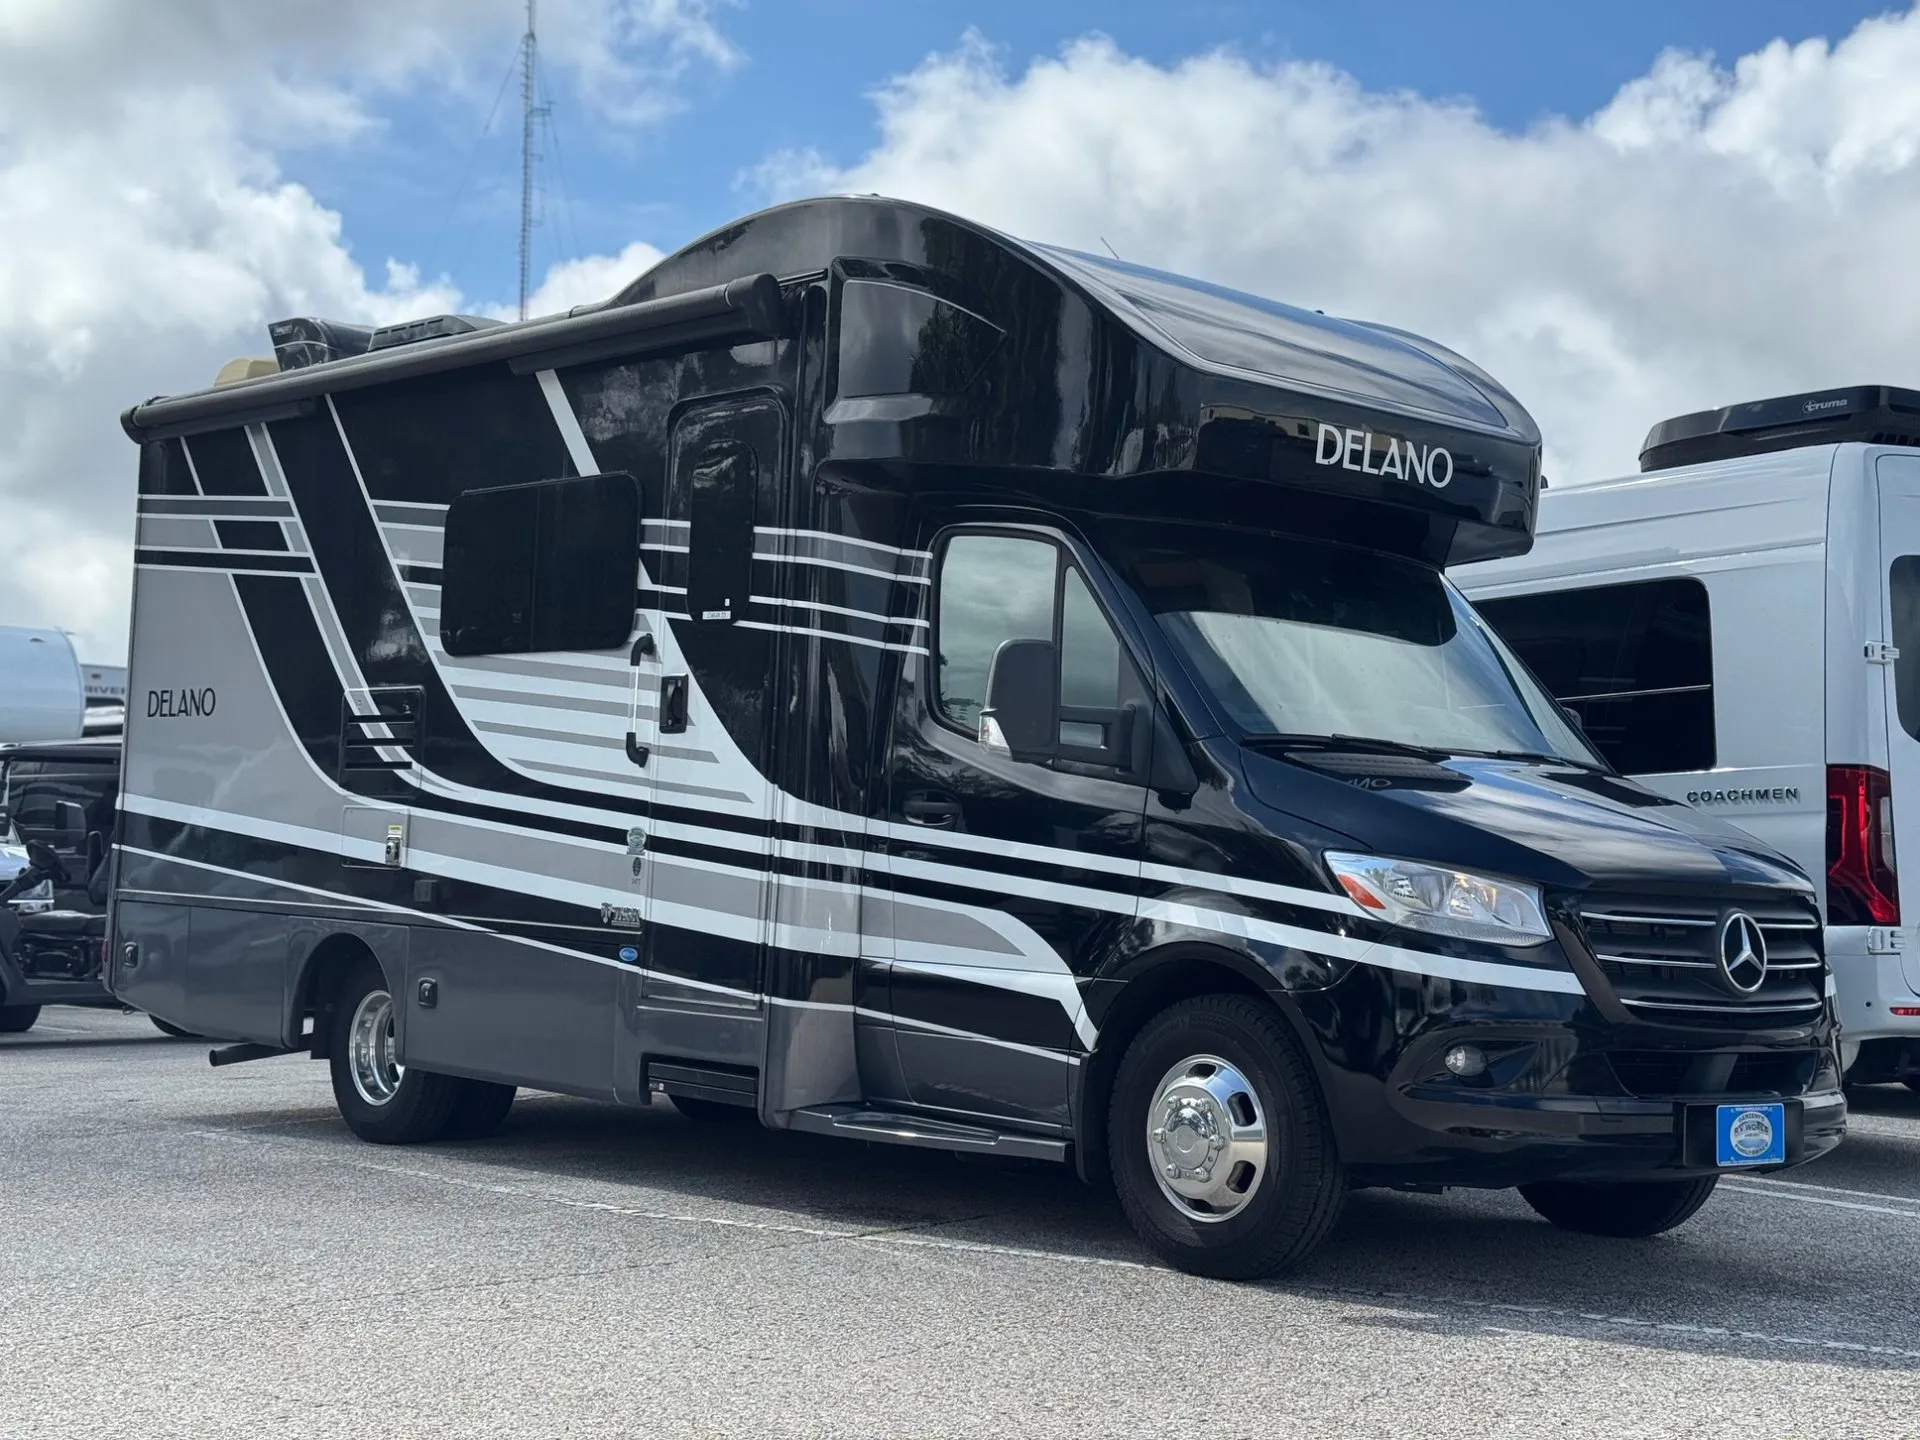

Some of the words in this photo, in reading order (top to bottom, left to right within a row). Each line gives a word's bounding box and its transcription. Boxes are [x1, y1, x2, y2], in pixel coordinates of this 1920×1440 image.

[1804, 399, 1847, 412] truma
[1315, 422, 1454, 488] DELANO
[147, 687, 216, 718] DELANO
[1686, 786, 1799, 804] COACHMEN
[1745, 1122, 1769, 1134] WORLD
